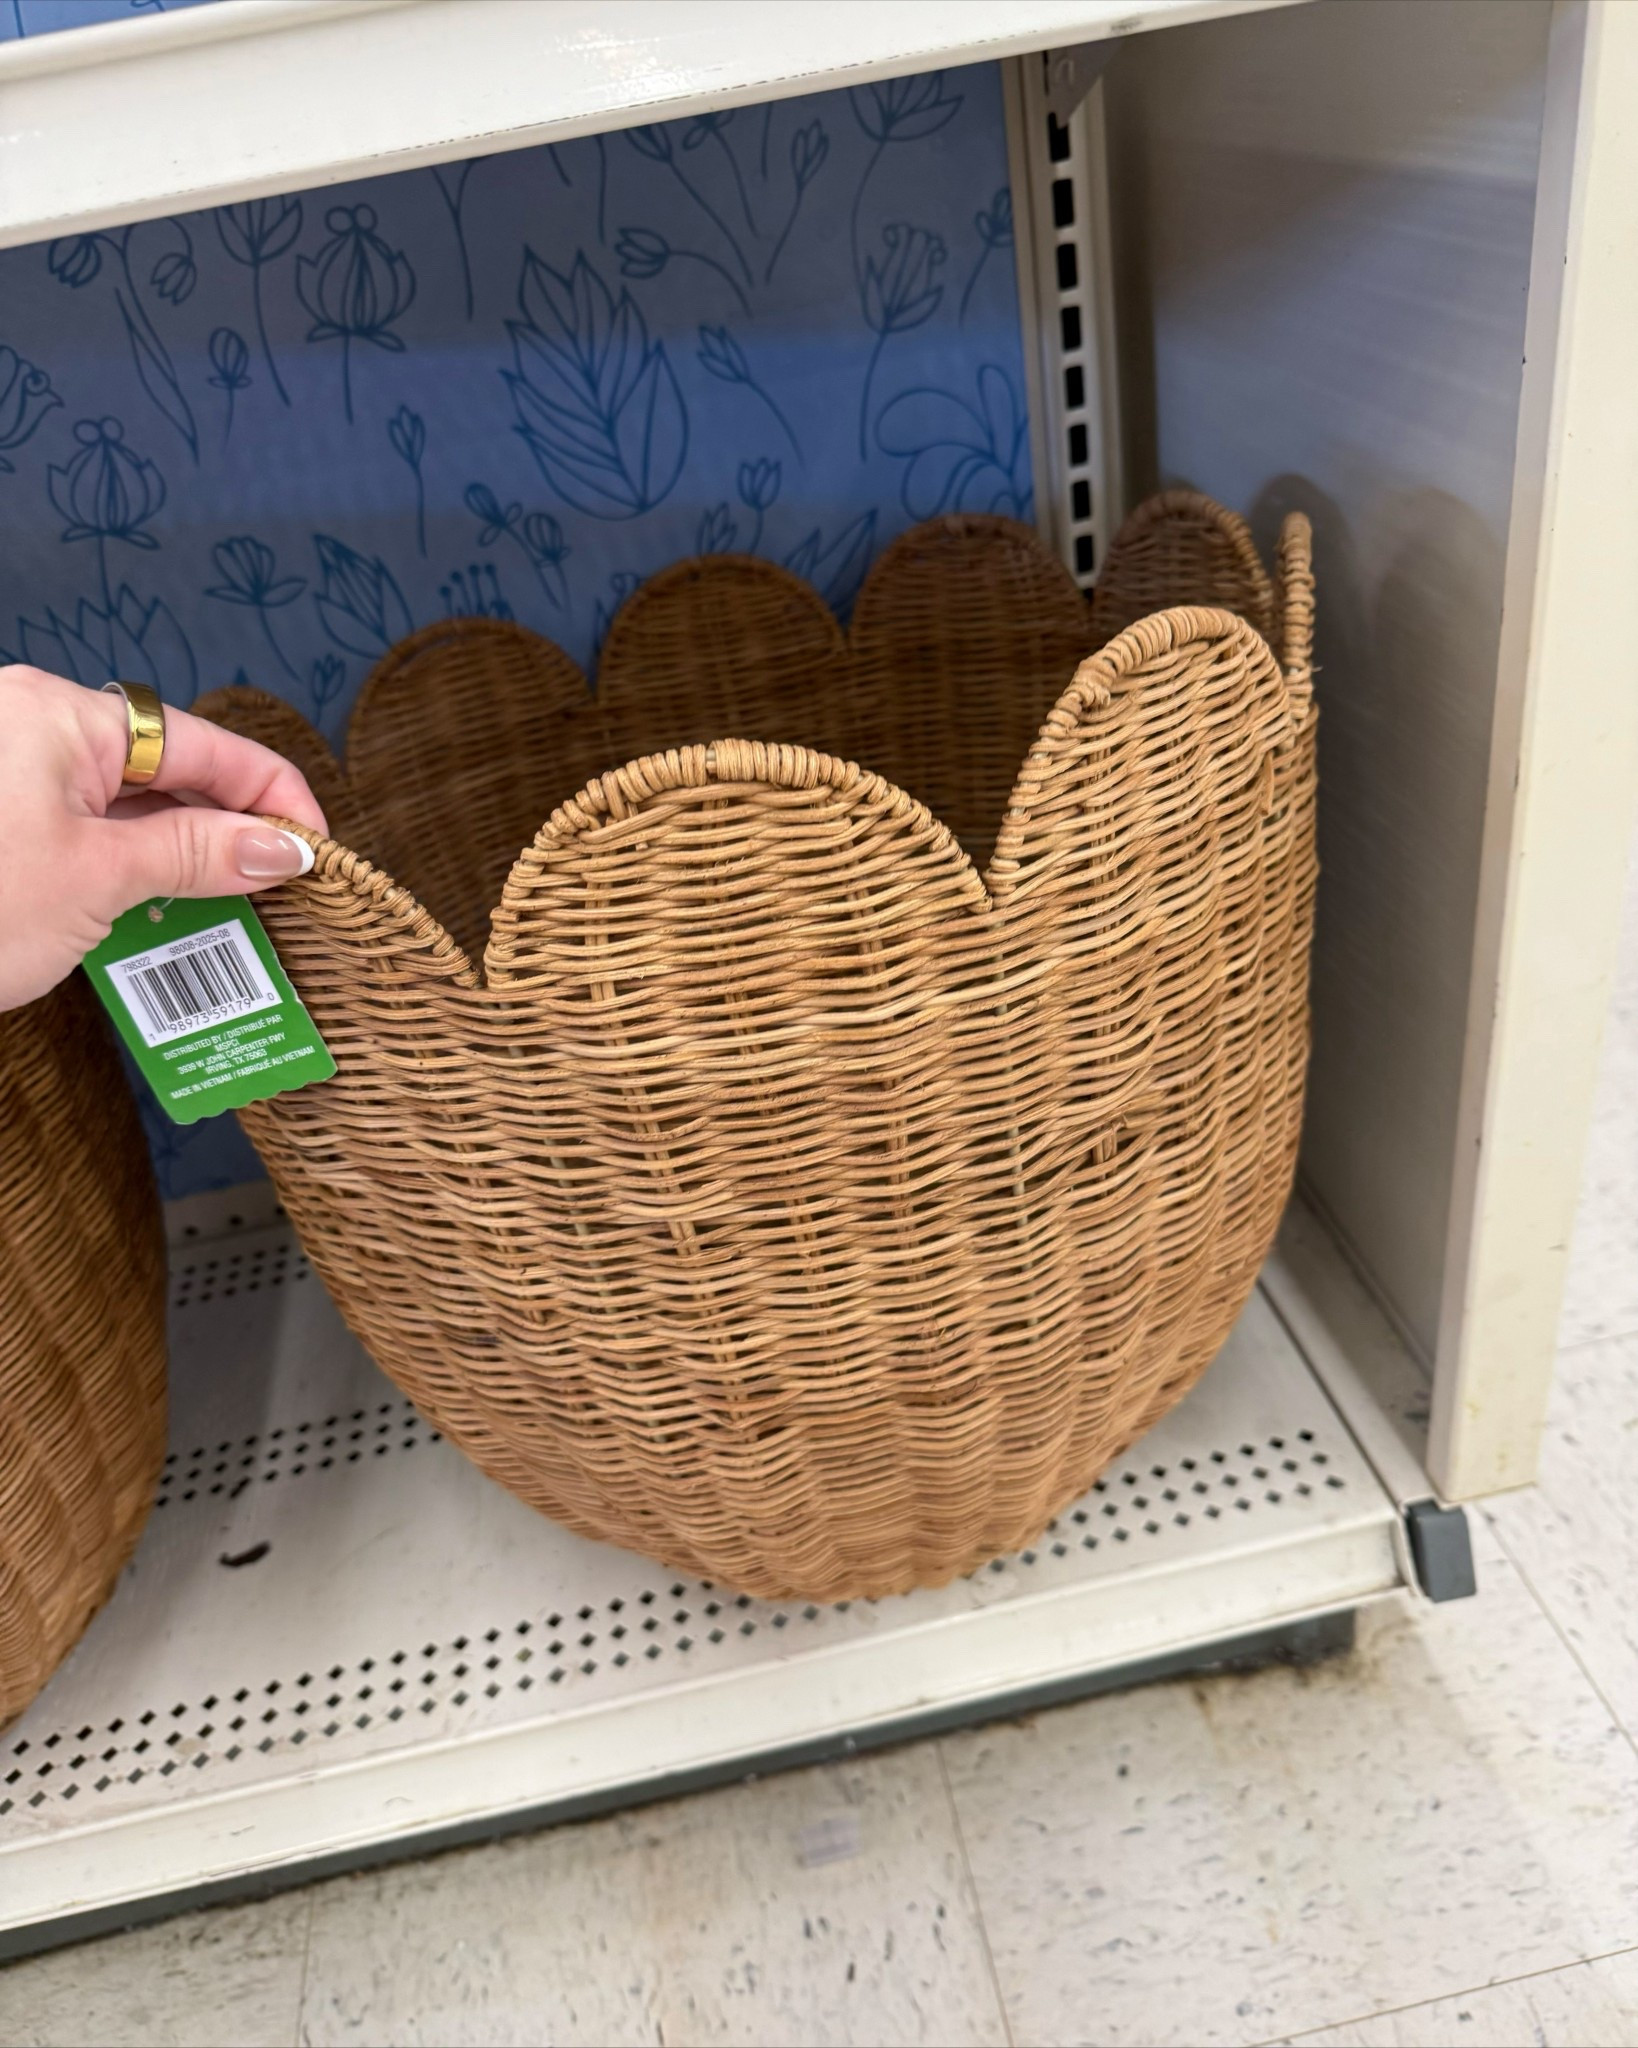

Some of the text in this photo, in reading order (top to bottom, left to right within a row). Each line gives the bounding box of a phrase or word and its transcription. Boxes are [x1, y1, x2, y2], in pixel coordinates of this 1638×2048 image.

[170, 1013, 210, 1033] 98973
[212, 998, 251, 1020] 59179
[267, 992, 275, 1001] 0
[163, 1036, 212, 1061] DISTRIBUTED
[211, 1034, 222, 1045] BY
[227, 1019, 266, 1039] DISTRIBUÉ
[266, 1014, 283, 1026] PAR
[195, 1060, 205, 1068] W
[206, 1054, 226, 1066] JOHN
[226, 1038, 270, 1059] CARPENTER
[269, 1032, 286, 1044] FWY
[170, 1087, 193, 1099] MADE
[192, 1084, 201, 1092] IN
[200, 1073, 233, 1090] VIETNAM
[237, 1060, 272, 1078] FABRIQUÉ
[272, 1057, 283, 1067] AU
[282, 1045, 316, 1062] VIETNAM
[234, 1055, 245, 1065] TX
